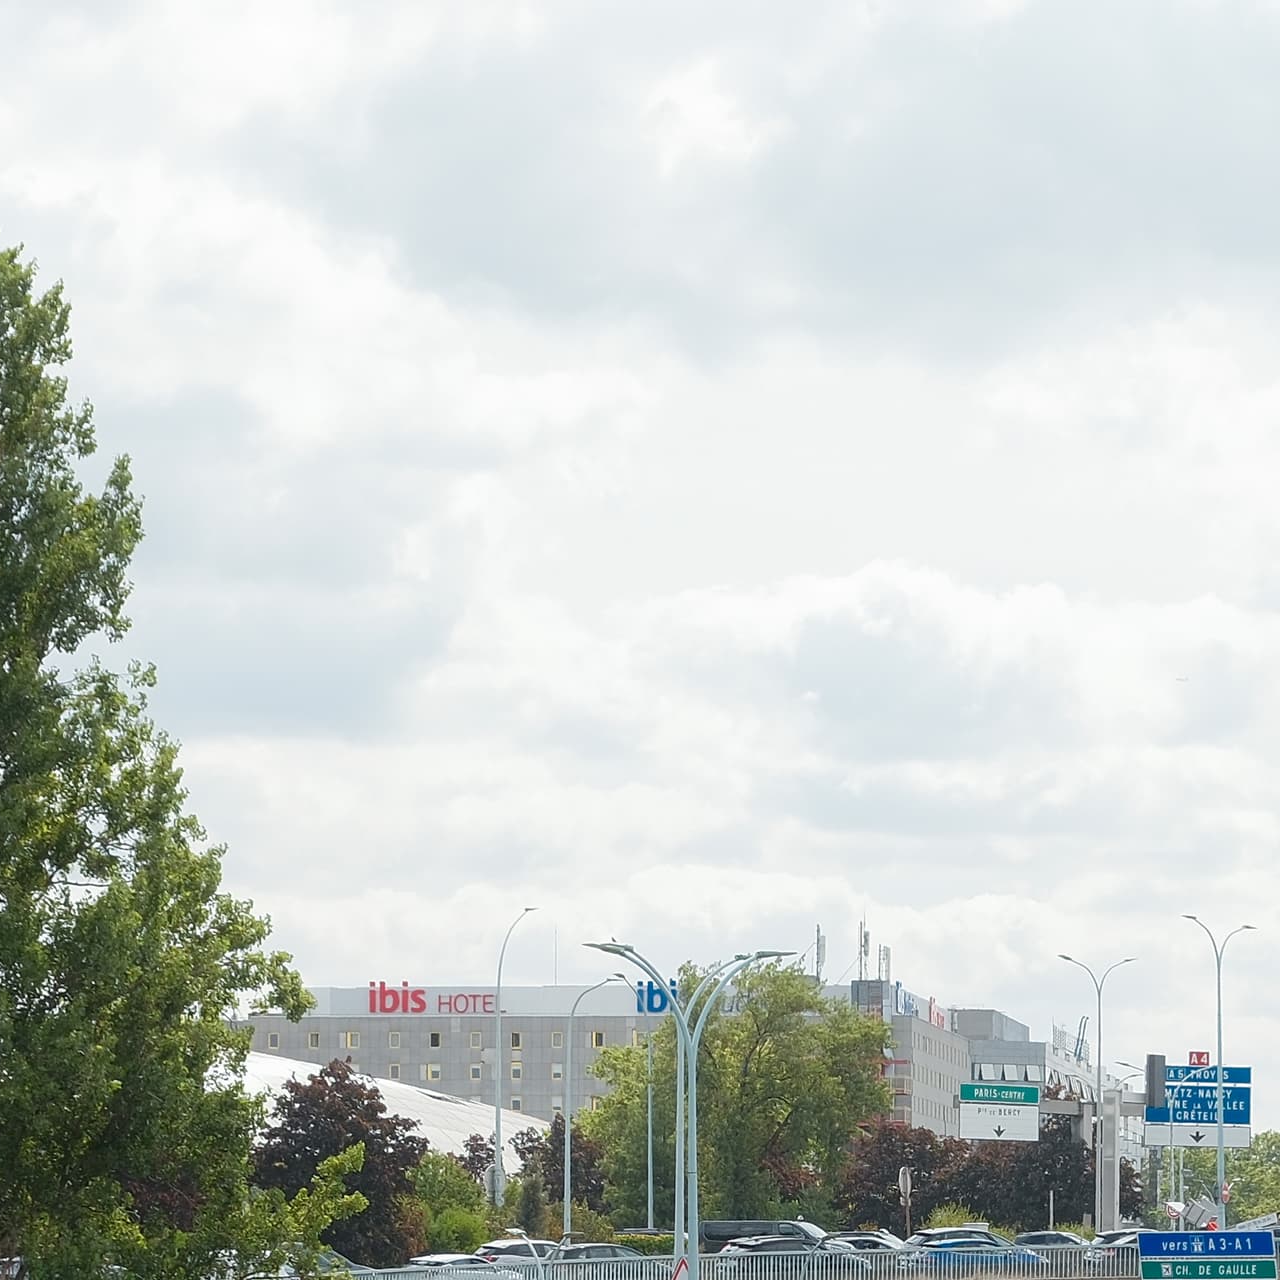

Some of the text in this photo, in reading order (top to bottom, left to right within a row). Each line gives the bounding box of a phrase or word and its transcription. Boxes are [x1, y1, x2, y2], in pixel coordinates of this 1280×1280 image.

[368, 981, 506, 1013] ibis HOTE
[636, 979, 678, 1013] ibi
[1190, 1070, 1230, 1080] TROYS
[1162, 1241, 1188, 1251] vers
[1175, 1264, 1257, 1276] CH. DE GAULLE
